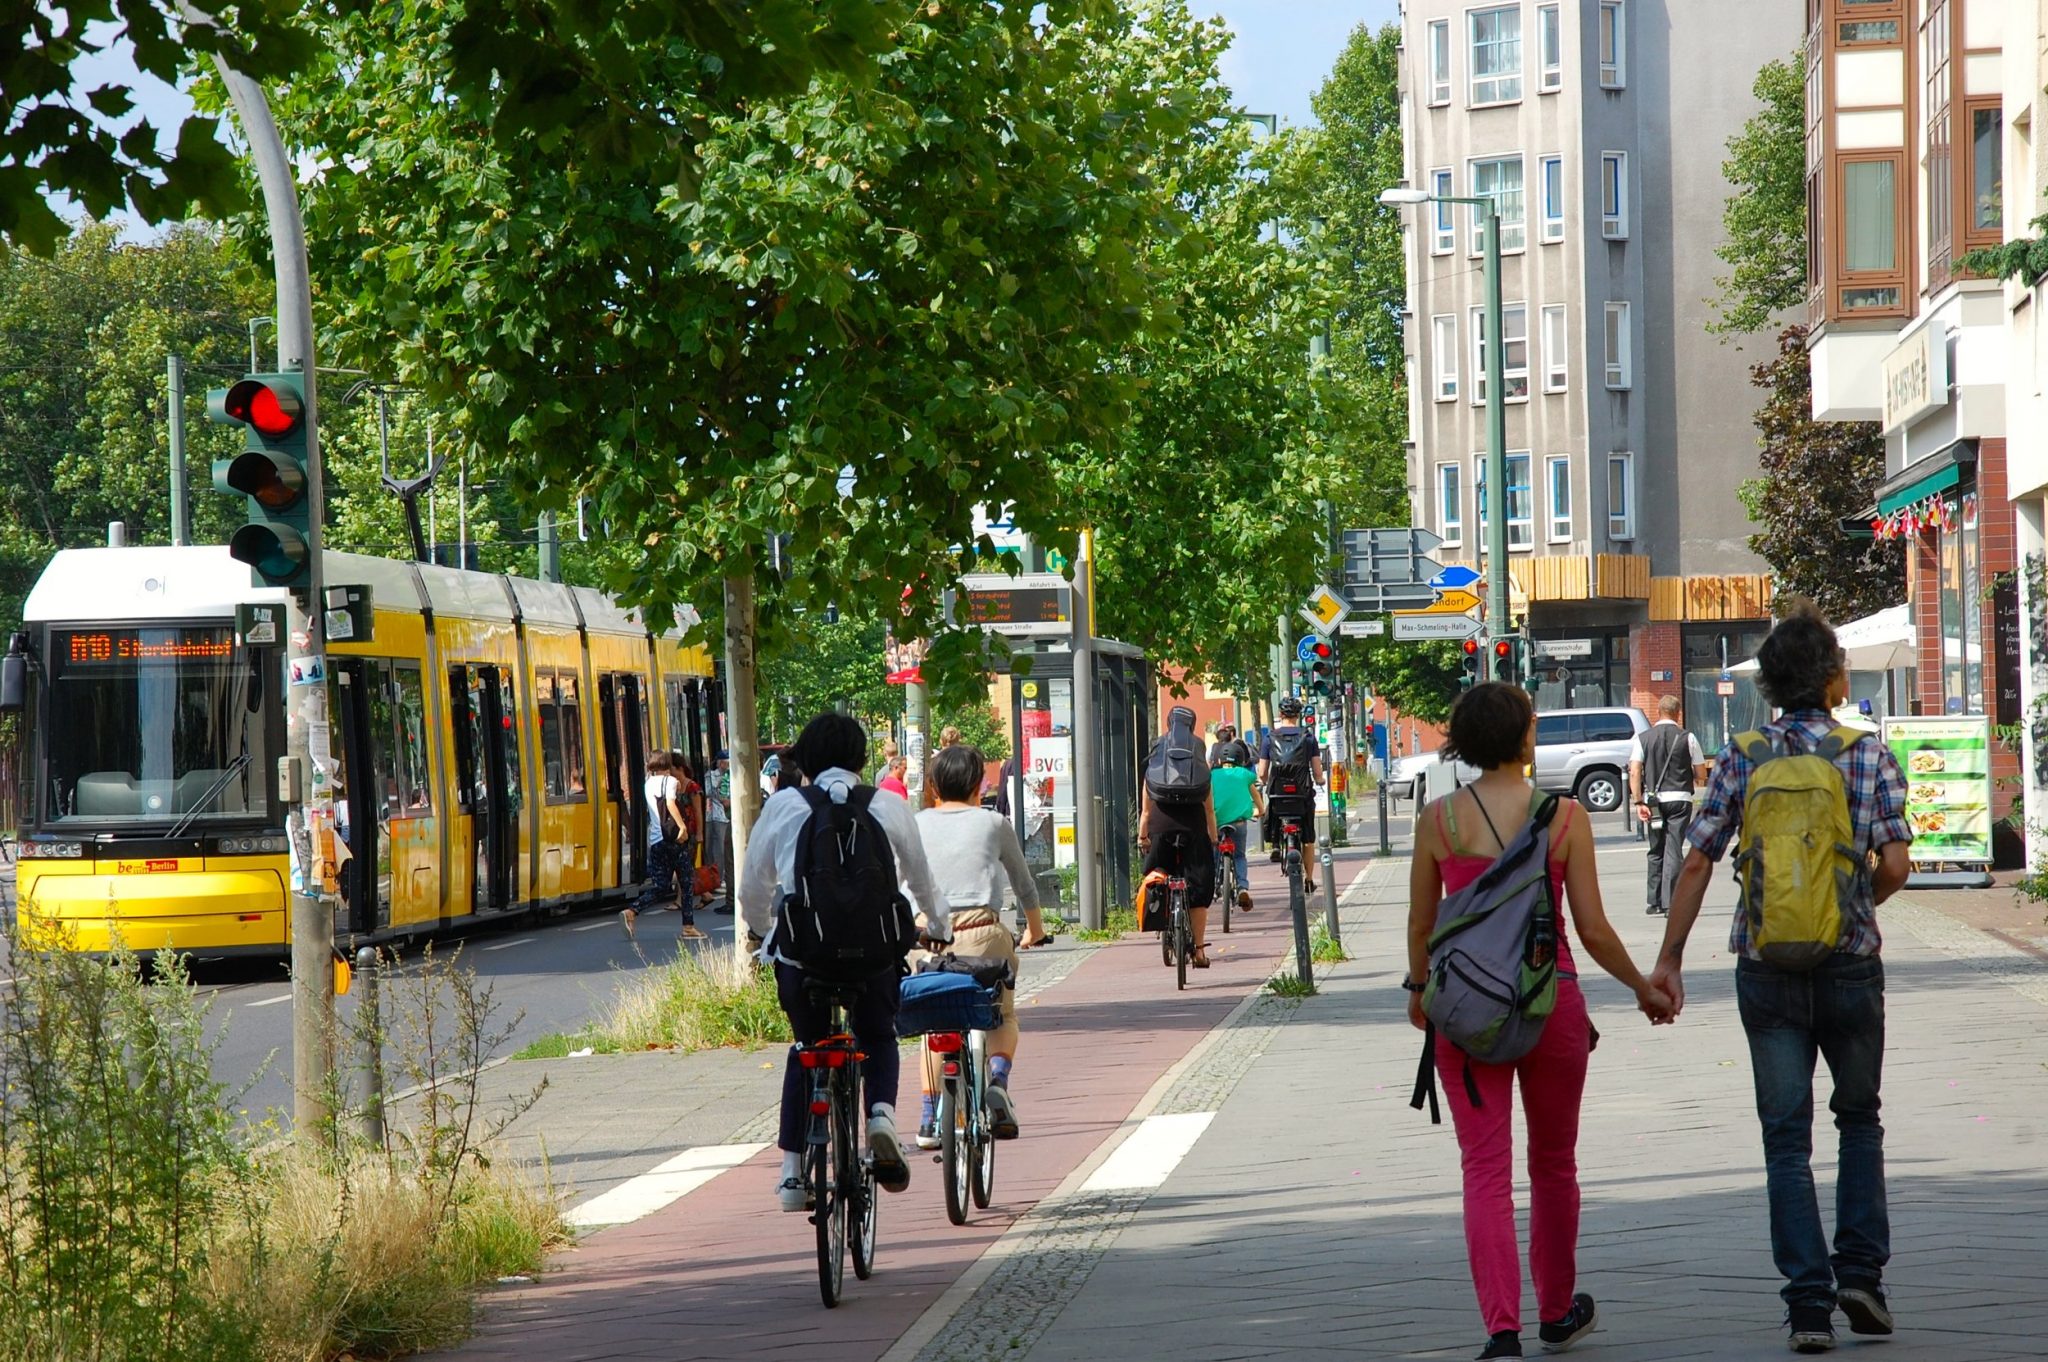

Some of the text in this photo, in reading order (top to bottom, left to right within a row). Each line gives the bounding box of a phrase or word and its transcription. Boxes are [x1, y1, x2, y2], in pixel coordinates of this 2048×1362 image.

[1401, 623, 1467, 632] Max-Schmeling-Halle
[71, 633, 232, 661] M10 S Nordbahnhof
[1035, 758, 1064, 772] BVG
[118, 861, 176, 873] be Berlin
